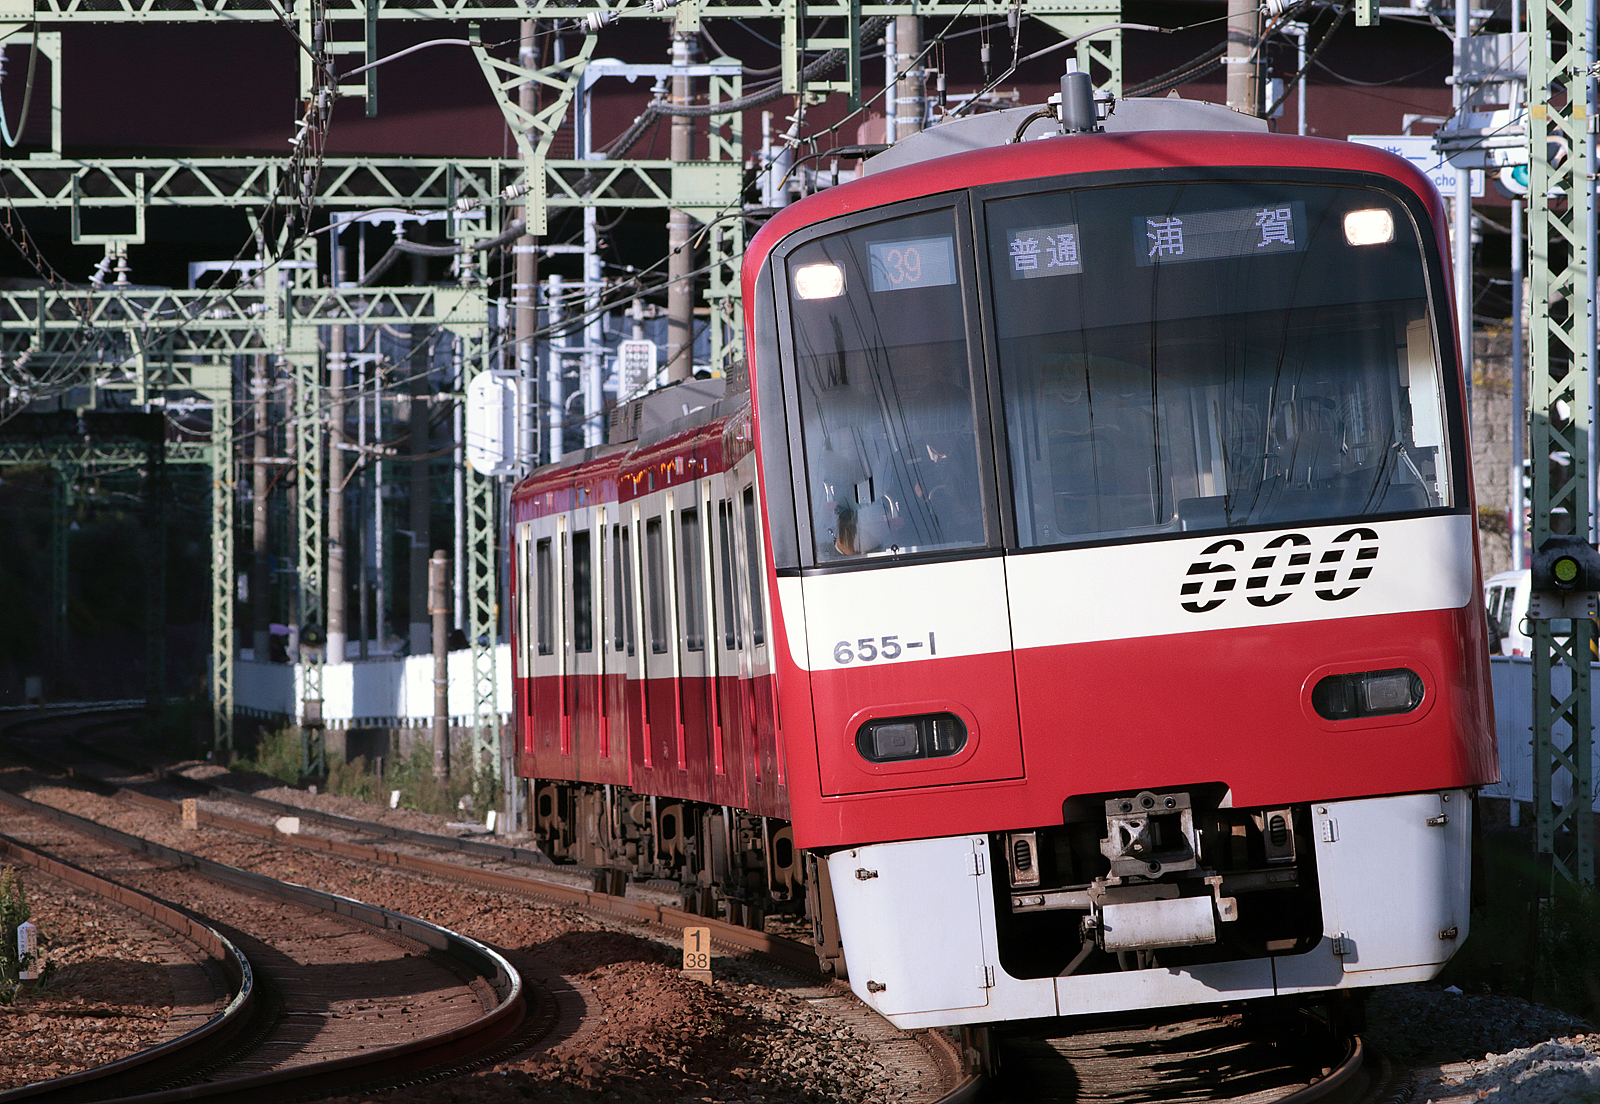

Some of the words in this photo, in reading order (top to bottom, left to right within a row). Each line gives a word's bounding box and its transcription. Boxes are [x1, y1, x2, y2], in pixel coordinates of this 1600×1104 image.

[1146, 208, 1295, 257] 浦賀
[887, 247, 921, 284] 39
[1009, 233, 1079, 271] 普通
[1180, 527, 1380, 613] 600
[833, 631, 937, 665] 655-1
[690, 930, 700, 952] 1
[686, 953, 707, 968] 38
